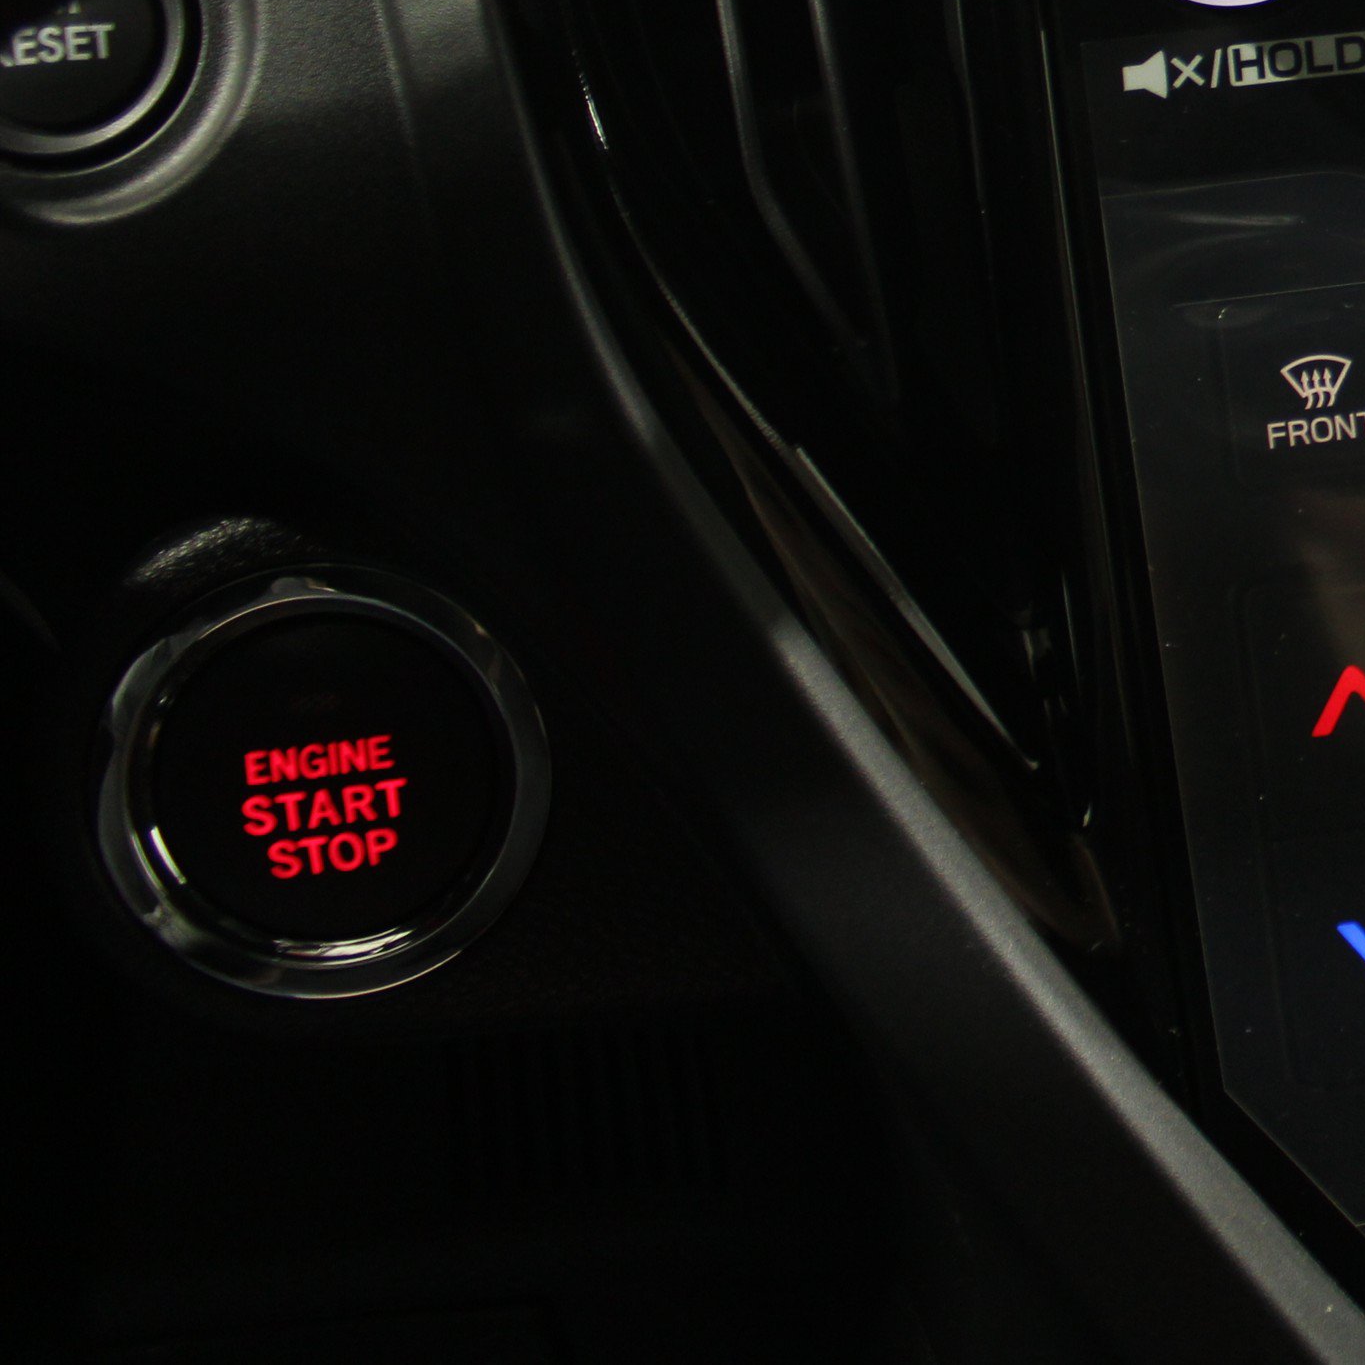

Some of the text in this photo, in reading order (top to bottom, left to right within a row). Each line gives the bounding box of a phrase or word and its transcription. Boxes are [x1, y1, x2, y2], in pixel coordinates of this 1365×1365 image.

[0, 21, 116, 68] ESET
[244, 735, 396, 786] ENGINE
[241, 777, 408, 837] START
[267, 827, 399, 879] STOP
